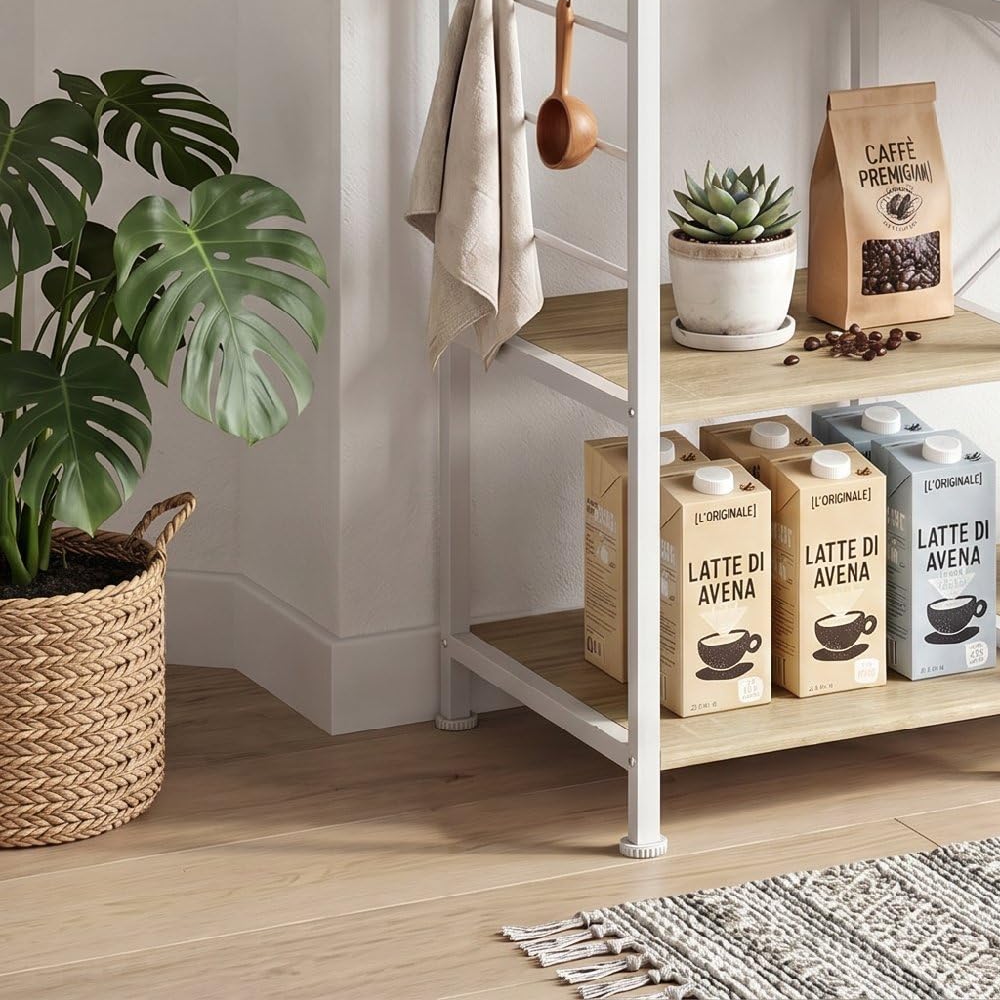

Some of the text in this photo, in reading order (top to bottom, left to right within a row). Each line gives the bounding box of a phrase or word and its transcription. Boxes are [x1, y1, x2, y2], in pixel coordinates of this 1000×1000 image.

[865, 135, 917, 165] CAFFÈ
[918, 519, 989, 549] LATTE DI
[805, 534, 878, 565] LATTE DI
[926, 545, 981, 572] AVENA
[688, 551, 764, 583] LATTE DI
[813, 561, 870, 589] AVENA
[698, 578, 756, 606] AVENA
